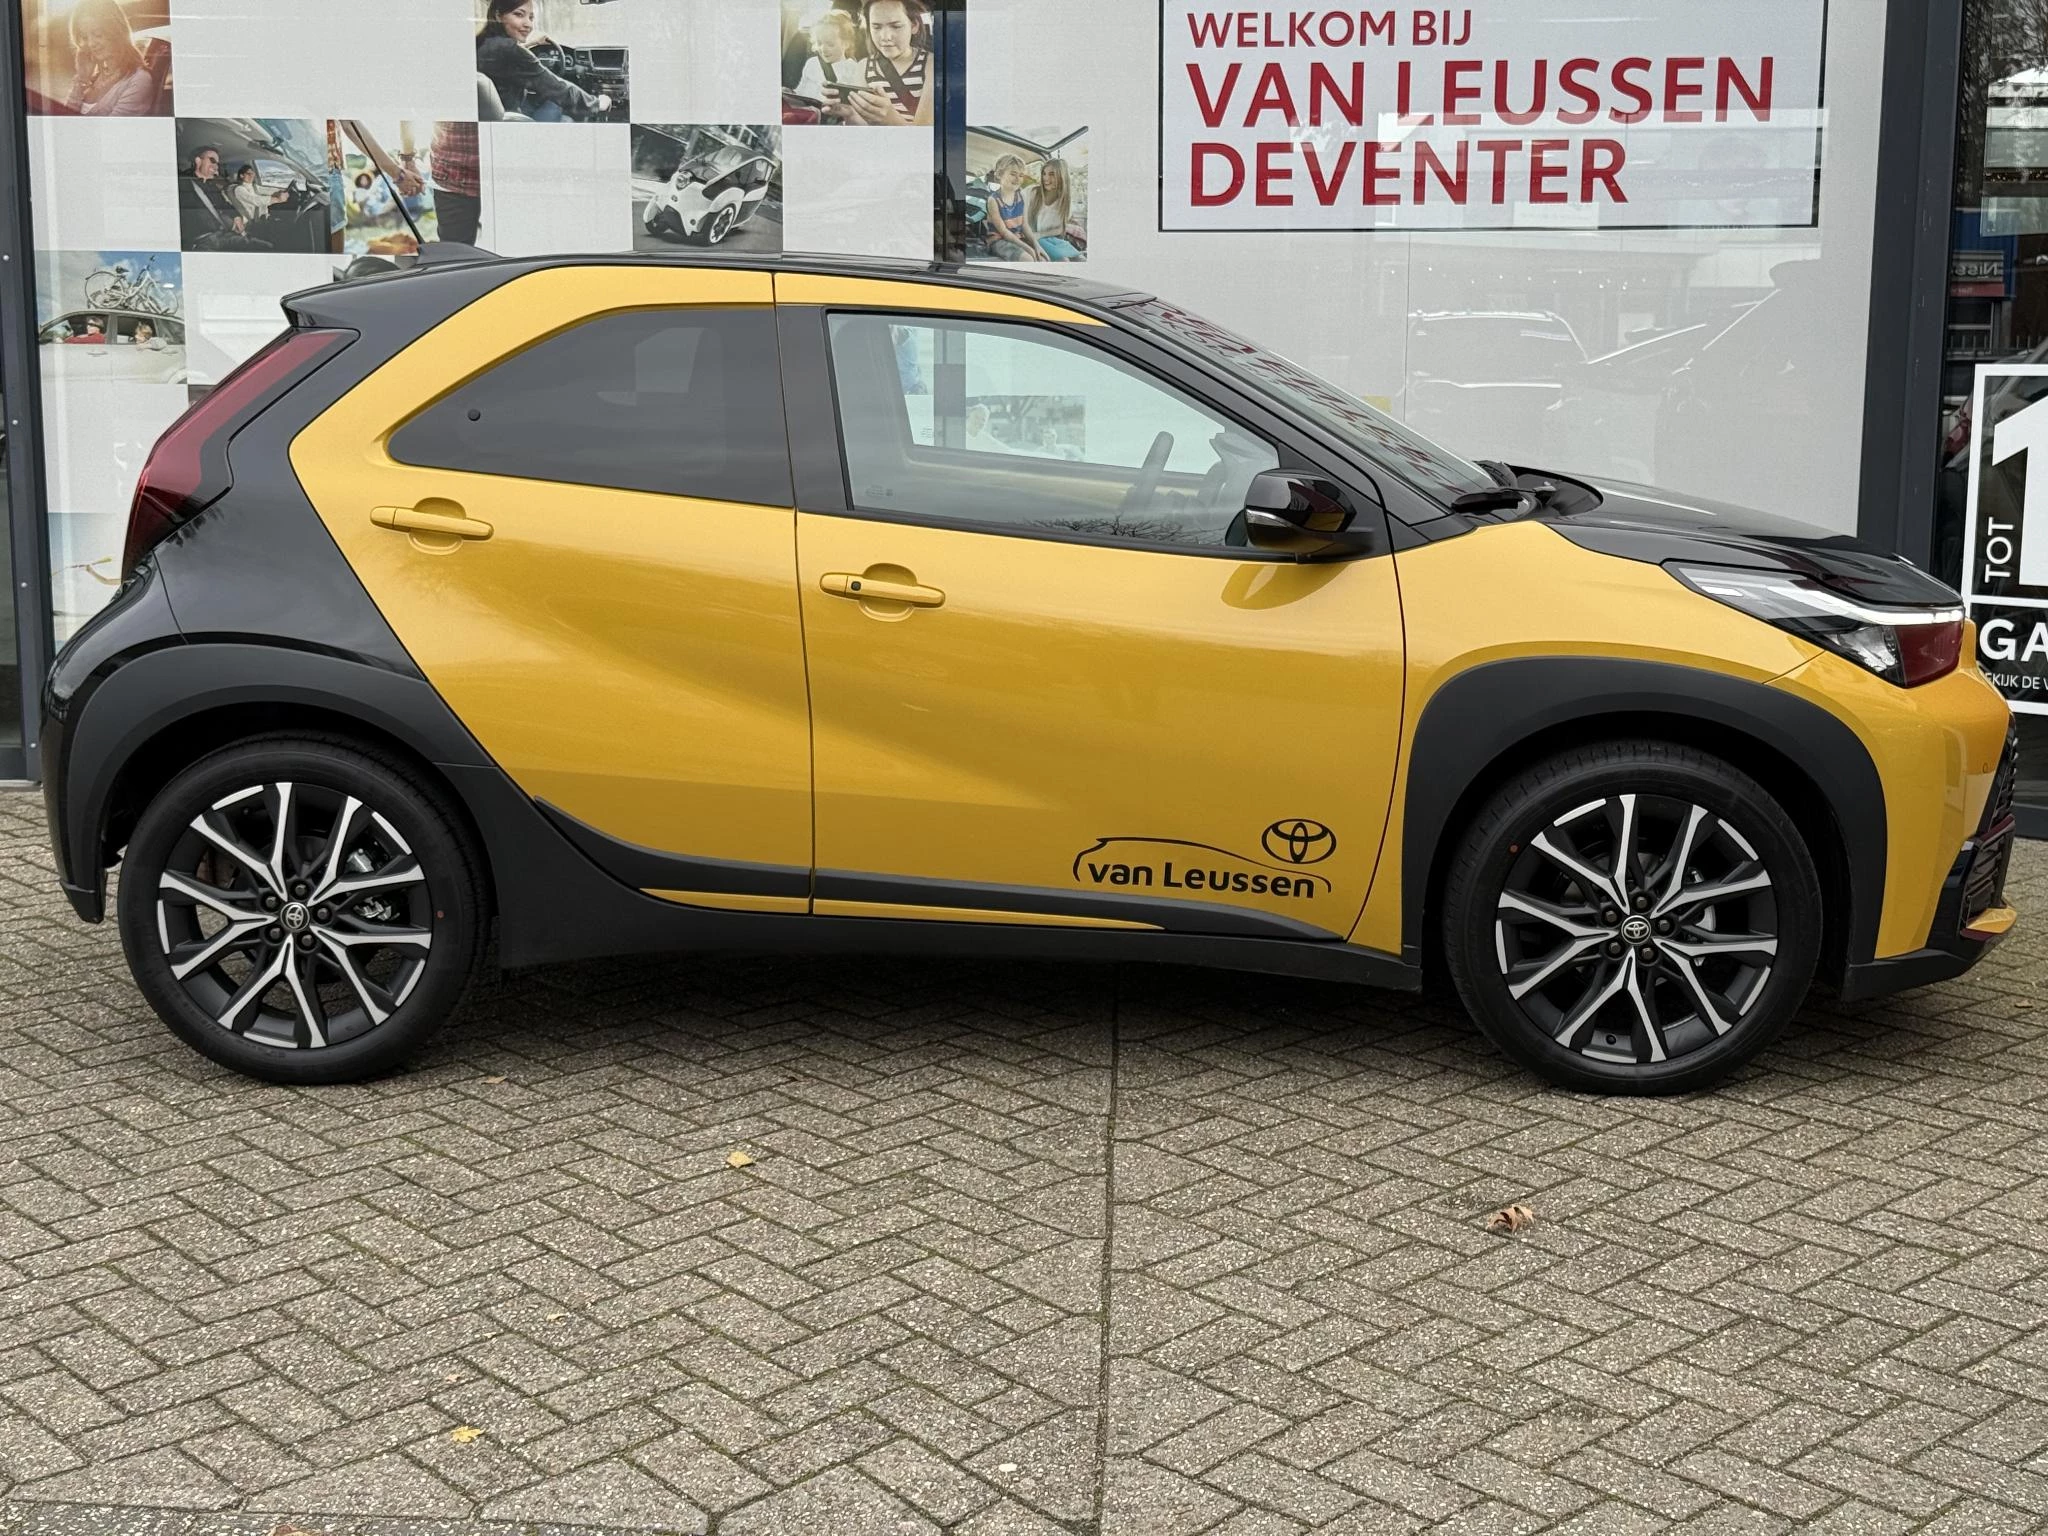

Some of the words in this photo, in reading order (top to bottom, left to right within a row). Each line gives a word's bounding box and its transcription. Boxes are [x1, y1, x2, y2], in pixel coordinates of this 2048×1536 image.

[1187, 11, 1395, 48] WELKOM
[1412, 10, 1471, 46] BIJ
[1186, 62, 1364, 128] VAN
[1398, 56, 1774, 125] LEUSSEN
[1190, 139, 1628, 207] DEVENTER
[1985, 516, 2014, 583] TOT
[2021, 675, 2041, 690] DE
[1087, 862, 1153, 886] van
[1163, 862, 1315, 899] Leussen
